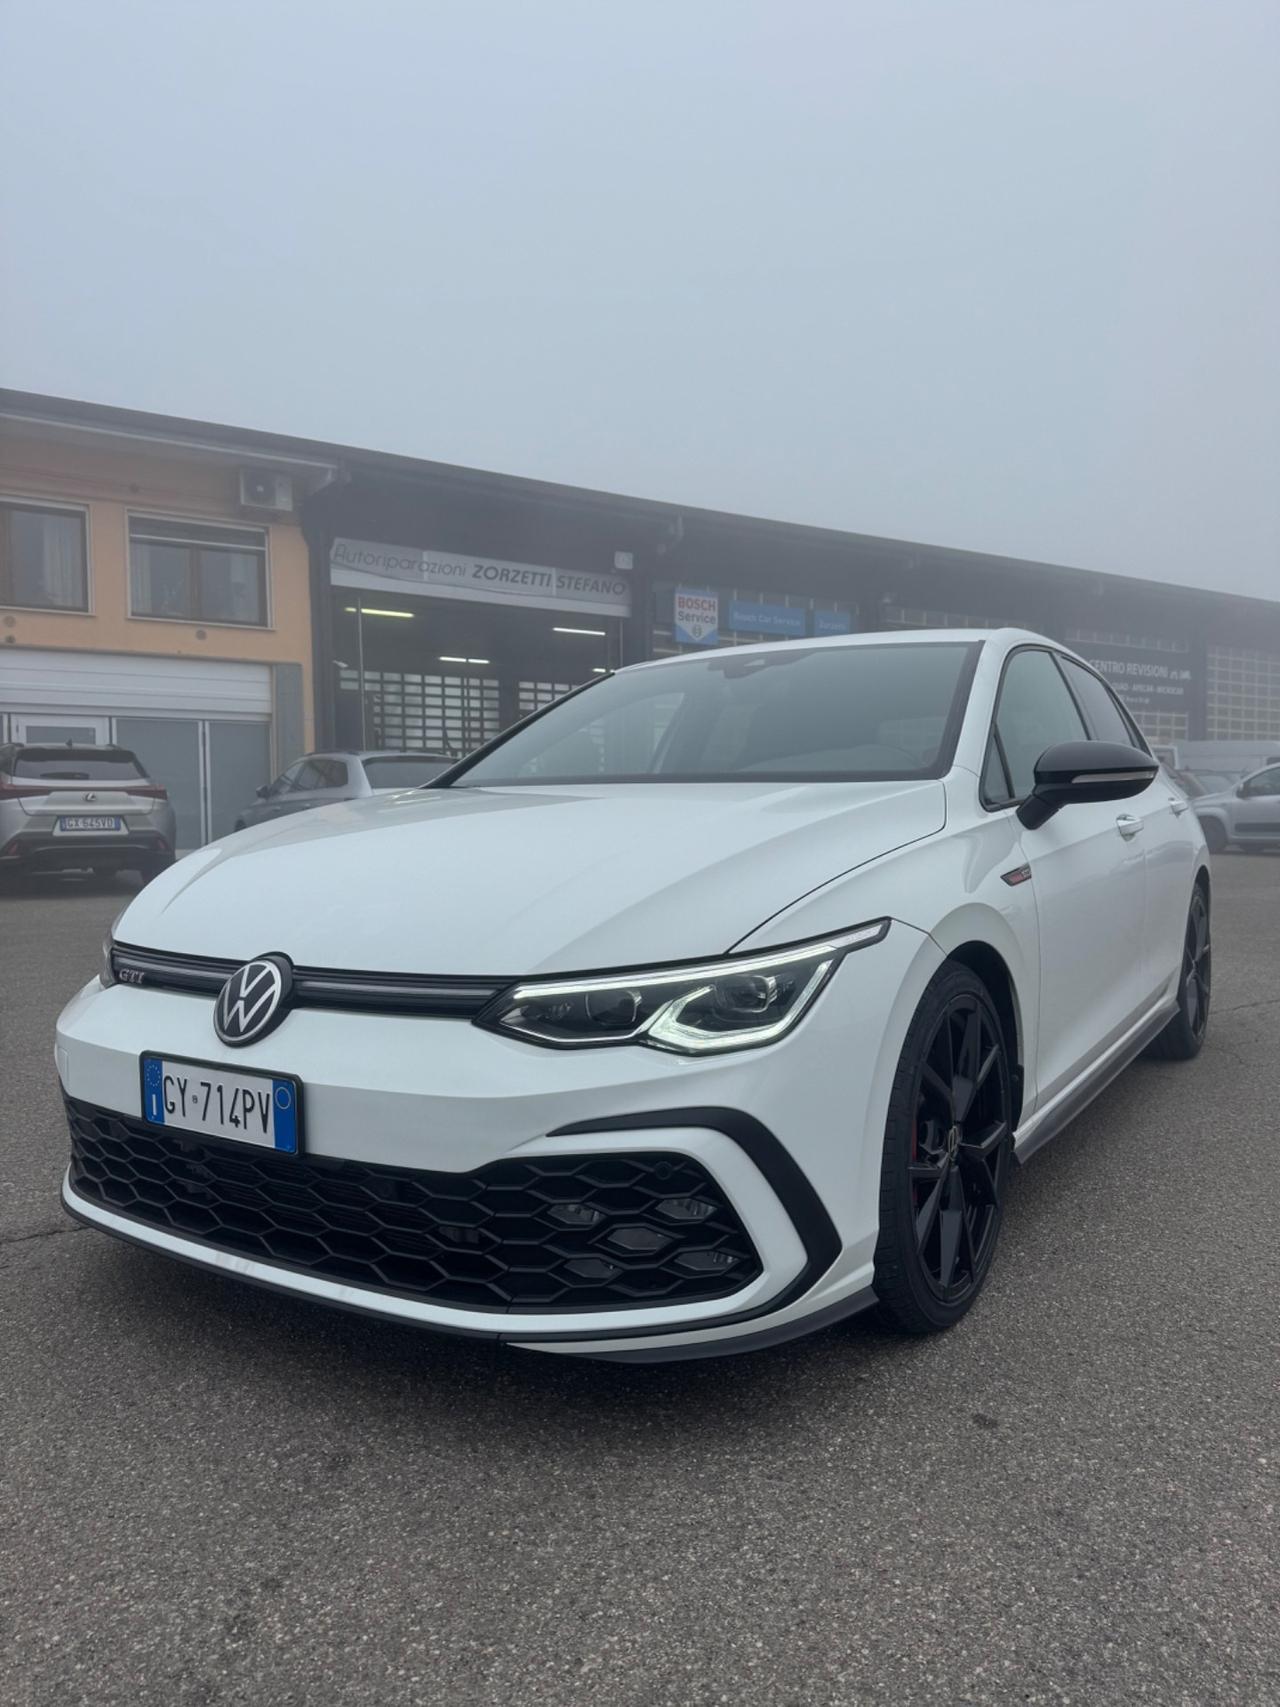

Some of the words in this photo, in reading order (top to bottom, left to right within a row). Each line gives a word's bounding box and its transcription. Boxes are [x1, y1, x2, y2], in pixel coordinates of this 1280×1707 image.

[333, 543, 466, 577] Autoriparazioni
[472, 564, 551, 587] ZORZETTI
[556, 574, 626, 596] STEFANO
[678, 596, 716, 612] BOSCH
[678, 610, 716, 624] Service
[119, 968, 145, 984] GTI
[163, 1075, 188, 1118] GY
[200, 1081, 270, 1134] 714PV
